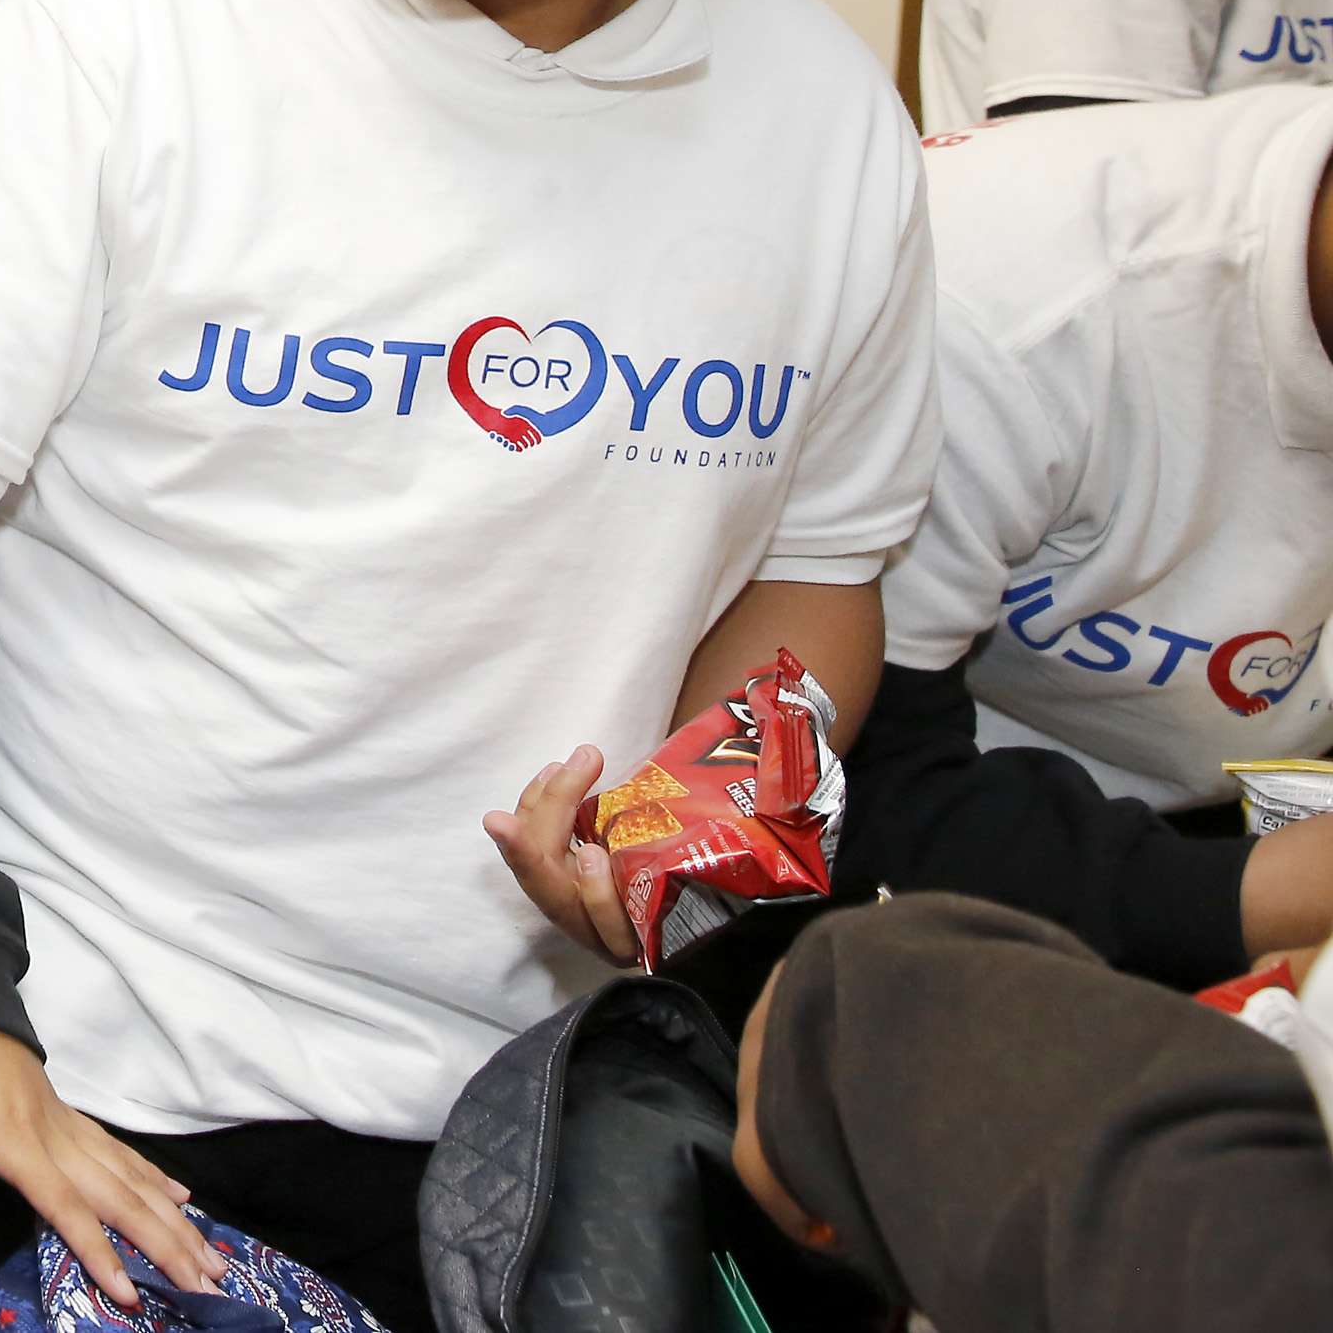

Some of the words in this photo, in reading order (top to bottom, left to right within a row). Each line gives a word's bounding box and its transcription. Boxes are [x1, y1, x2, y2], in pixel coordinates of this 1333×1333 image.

[158, 322, 446, 415] JUST
[481, 354, 573, 392] FOR
[604, 444, 777, 467] FOUNDATION
[726, 781, 755, 818] CHEESE
[635, 872, 652, 902] 150
